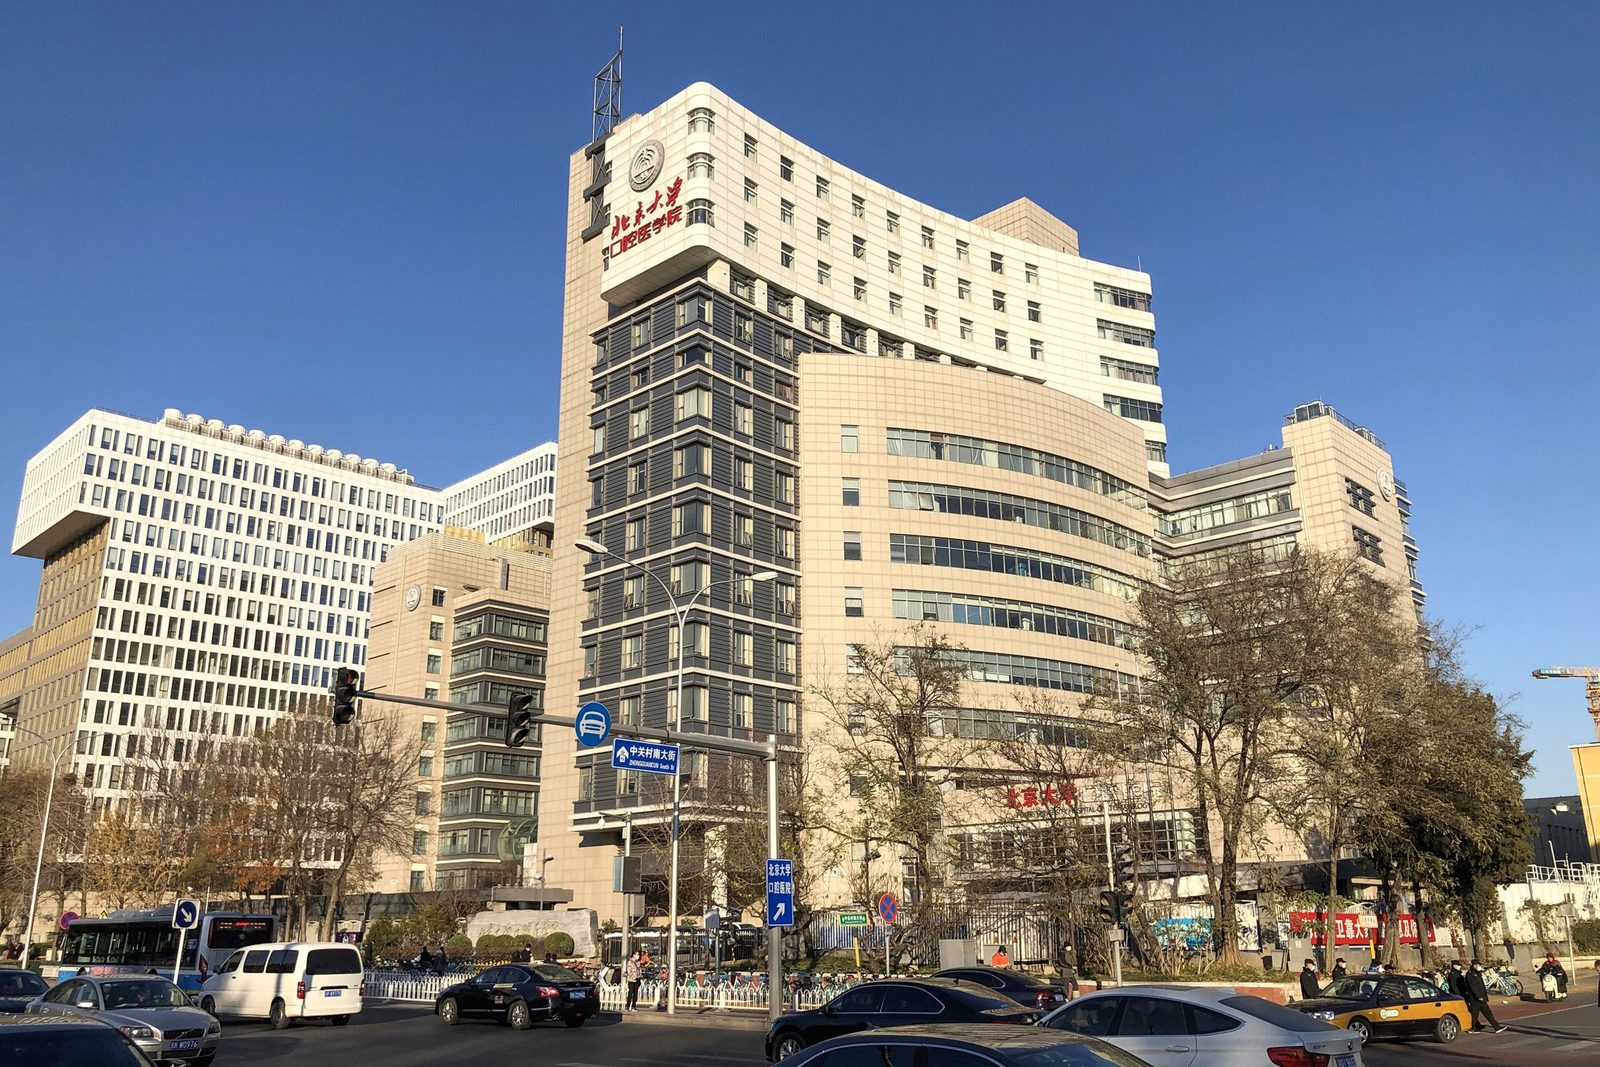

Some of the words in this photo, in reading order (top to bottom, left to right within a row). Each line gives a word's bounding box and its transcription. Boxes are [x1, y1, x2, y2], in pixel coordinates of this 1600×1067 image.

[611, 176, 683, 240] 北京大学
[610, 205, 683, 259] 口腔医学院
[629, 745, 676, 761] 中关村南大街
[768, 863, 791, 877] 北京大学
[768, 881, 791, 894] 口腔医院
